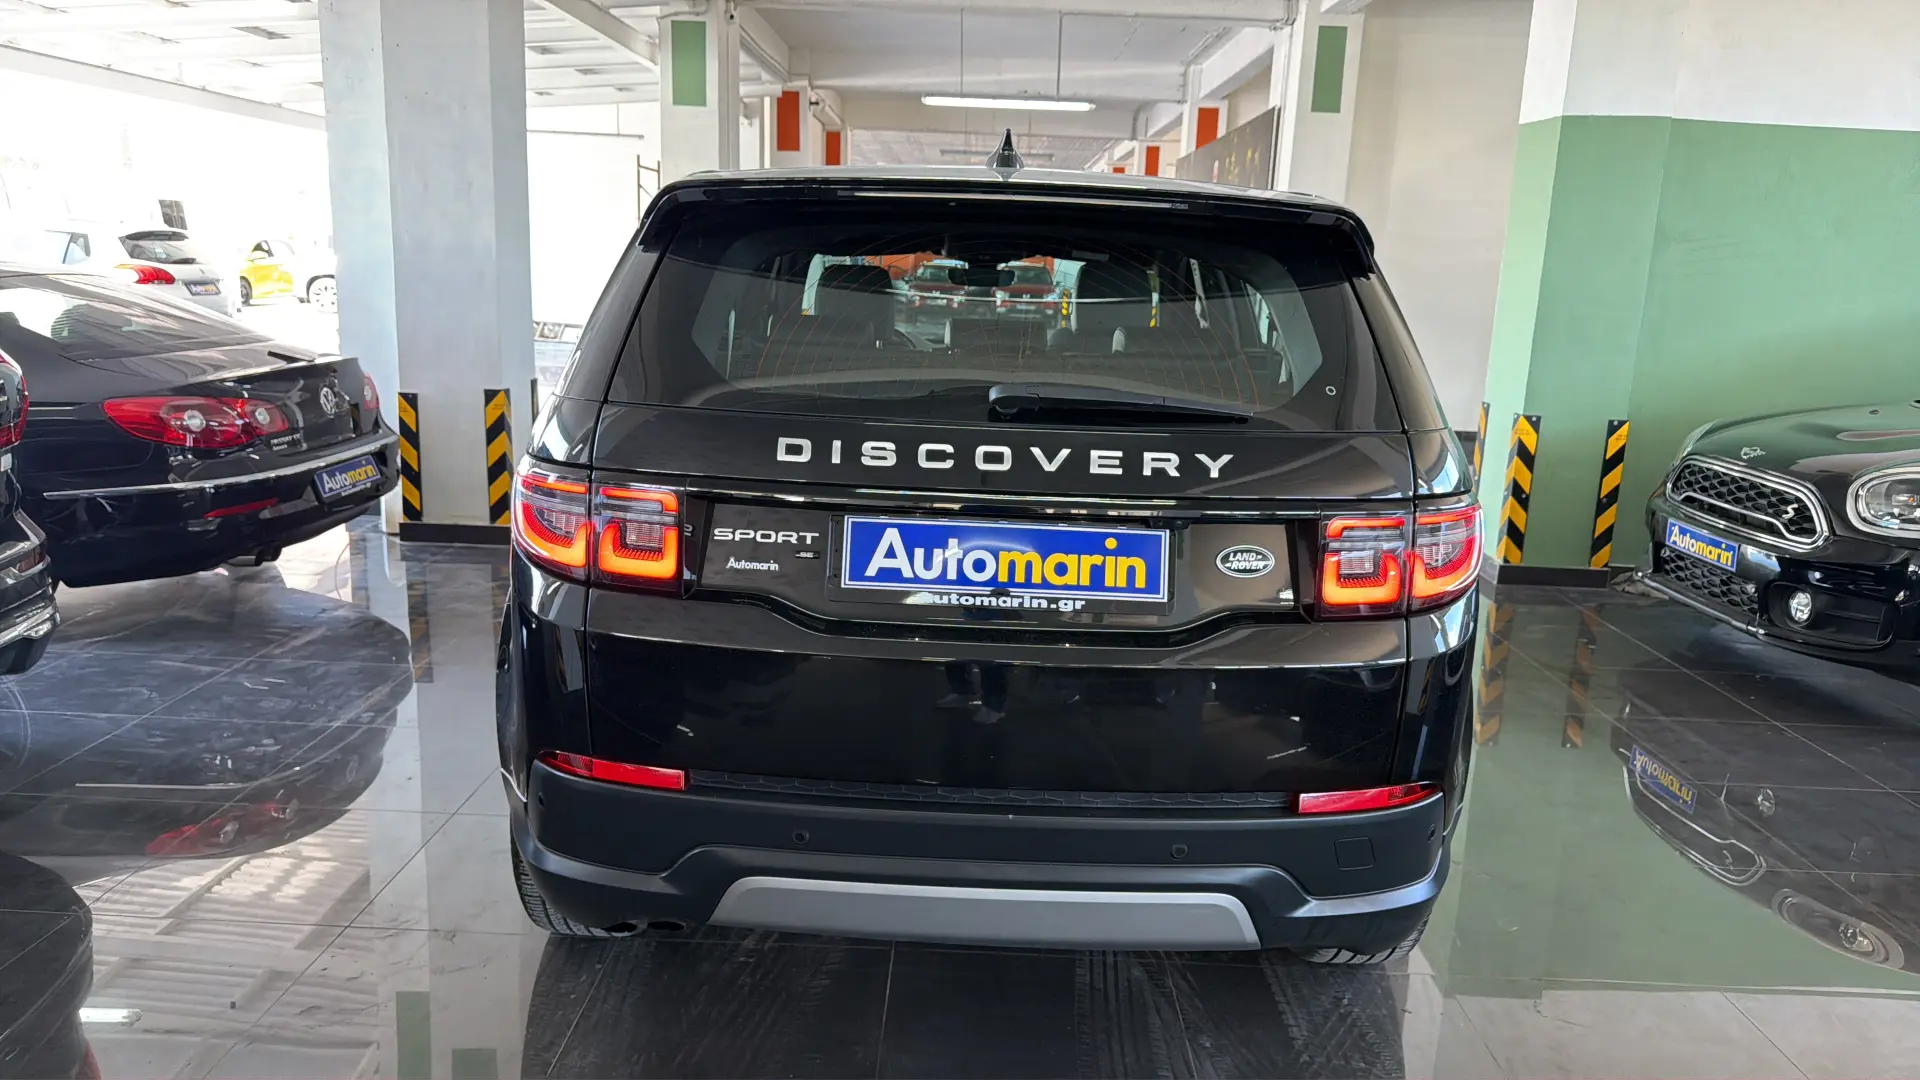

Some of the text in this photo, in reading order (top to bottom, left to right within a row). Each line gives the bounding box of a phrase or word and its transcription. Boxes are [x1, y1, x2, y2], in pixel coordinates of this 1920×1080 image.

[775, 436, 1234, 479] DISCOVERY
[322, 460, 376, 493] Automarin
[713, 527, 820, 545] SPORT
[1670, 525, 1733, 567] Automarin
[726, 556, 779, 571] Automarin
[864, 527, 1146, 588] Automarin
[1229, 552, 1256, 561] LAND
[1231, 560, 1265, 570] ROVER
